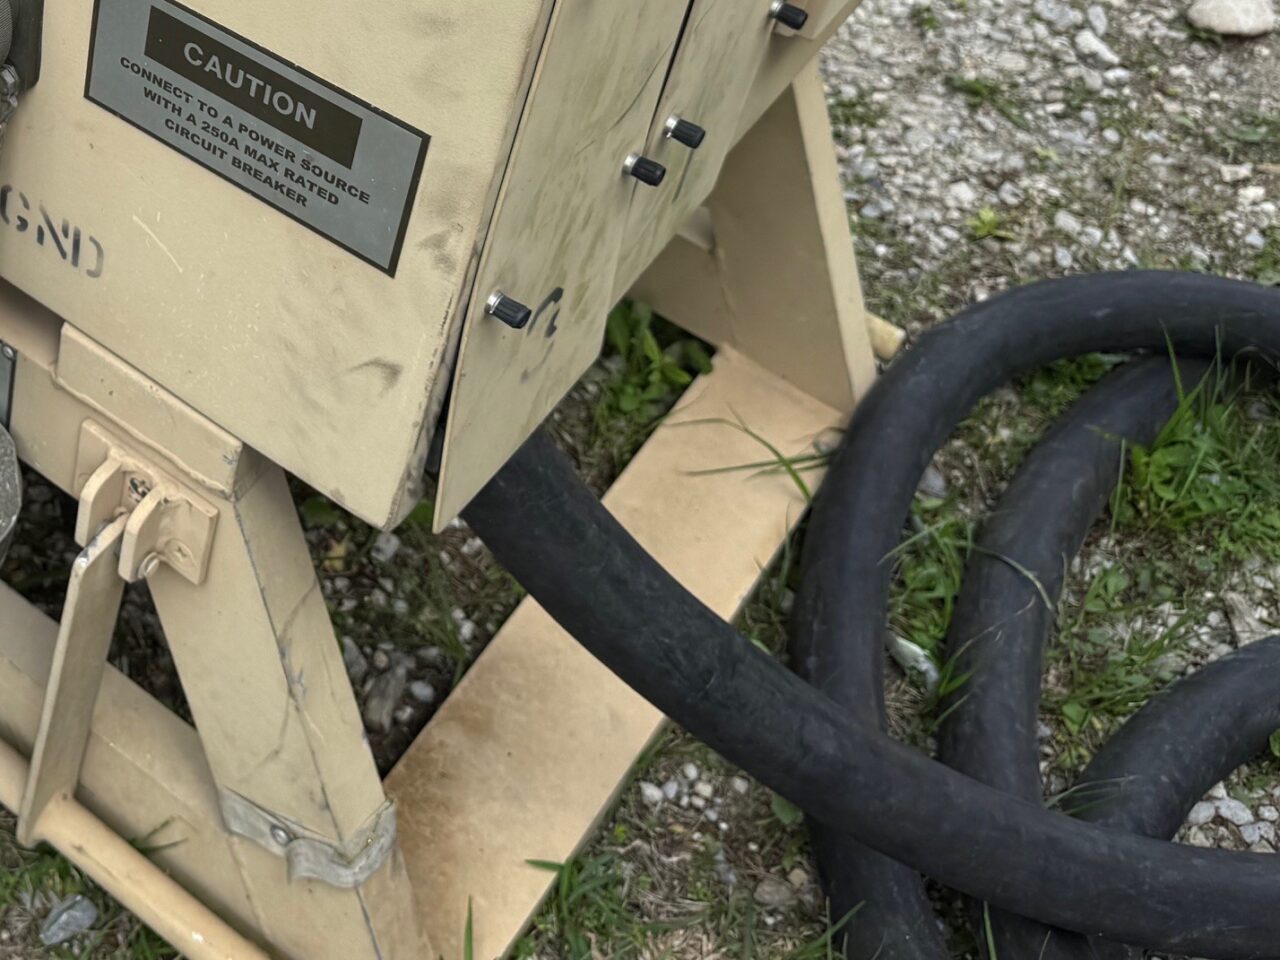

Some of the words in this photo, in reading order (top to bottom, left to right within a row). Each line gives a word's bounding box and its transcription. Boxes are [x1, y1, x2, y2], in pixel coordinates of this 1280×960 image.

[120, 56, 193, 104] CONNECT
[197, 100, 218, 119] TO
[222, 114, 234, 131] A
[238, 124, 296, 163] POWER
[300, 155, 370, 205] SOURCE
[183, 42, 317, 130] CAUTION
[143, 87, 182, 118] WITH
[186, 112, 198, 127] A
[201, 120, 240, 150] 250A
[244, 144, 280, 172] MAX
[284, 168, 339, 206] RATED
[165, 118, 228, 160] CIRCUIT
[232, 157, 308, 208] BREAKER
[0, 185, 104, 278] GND
